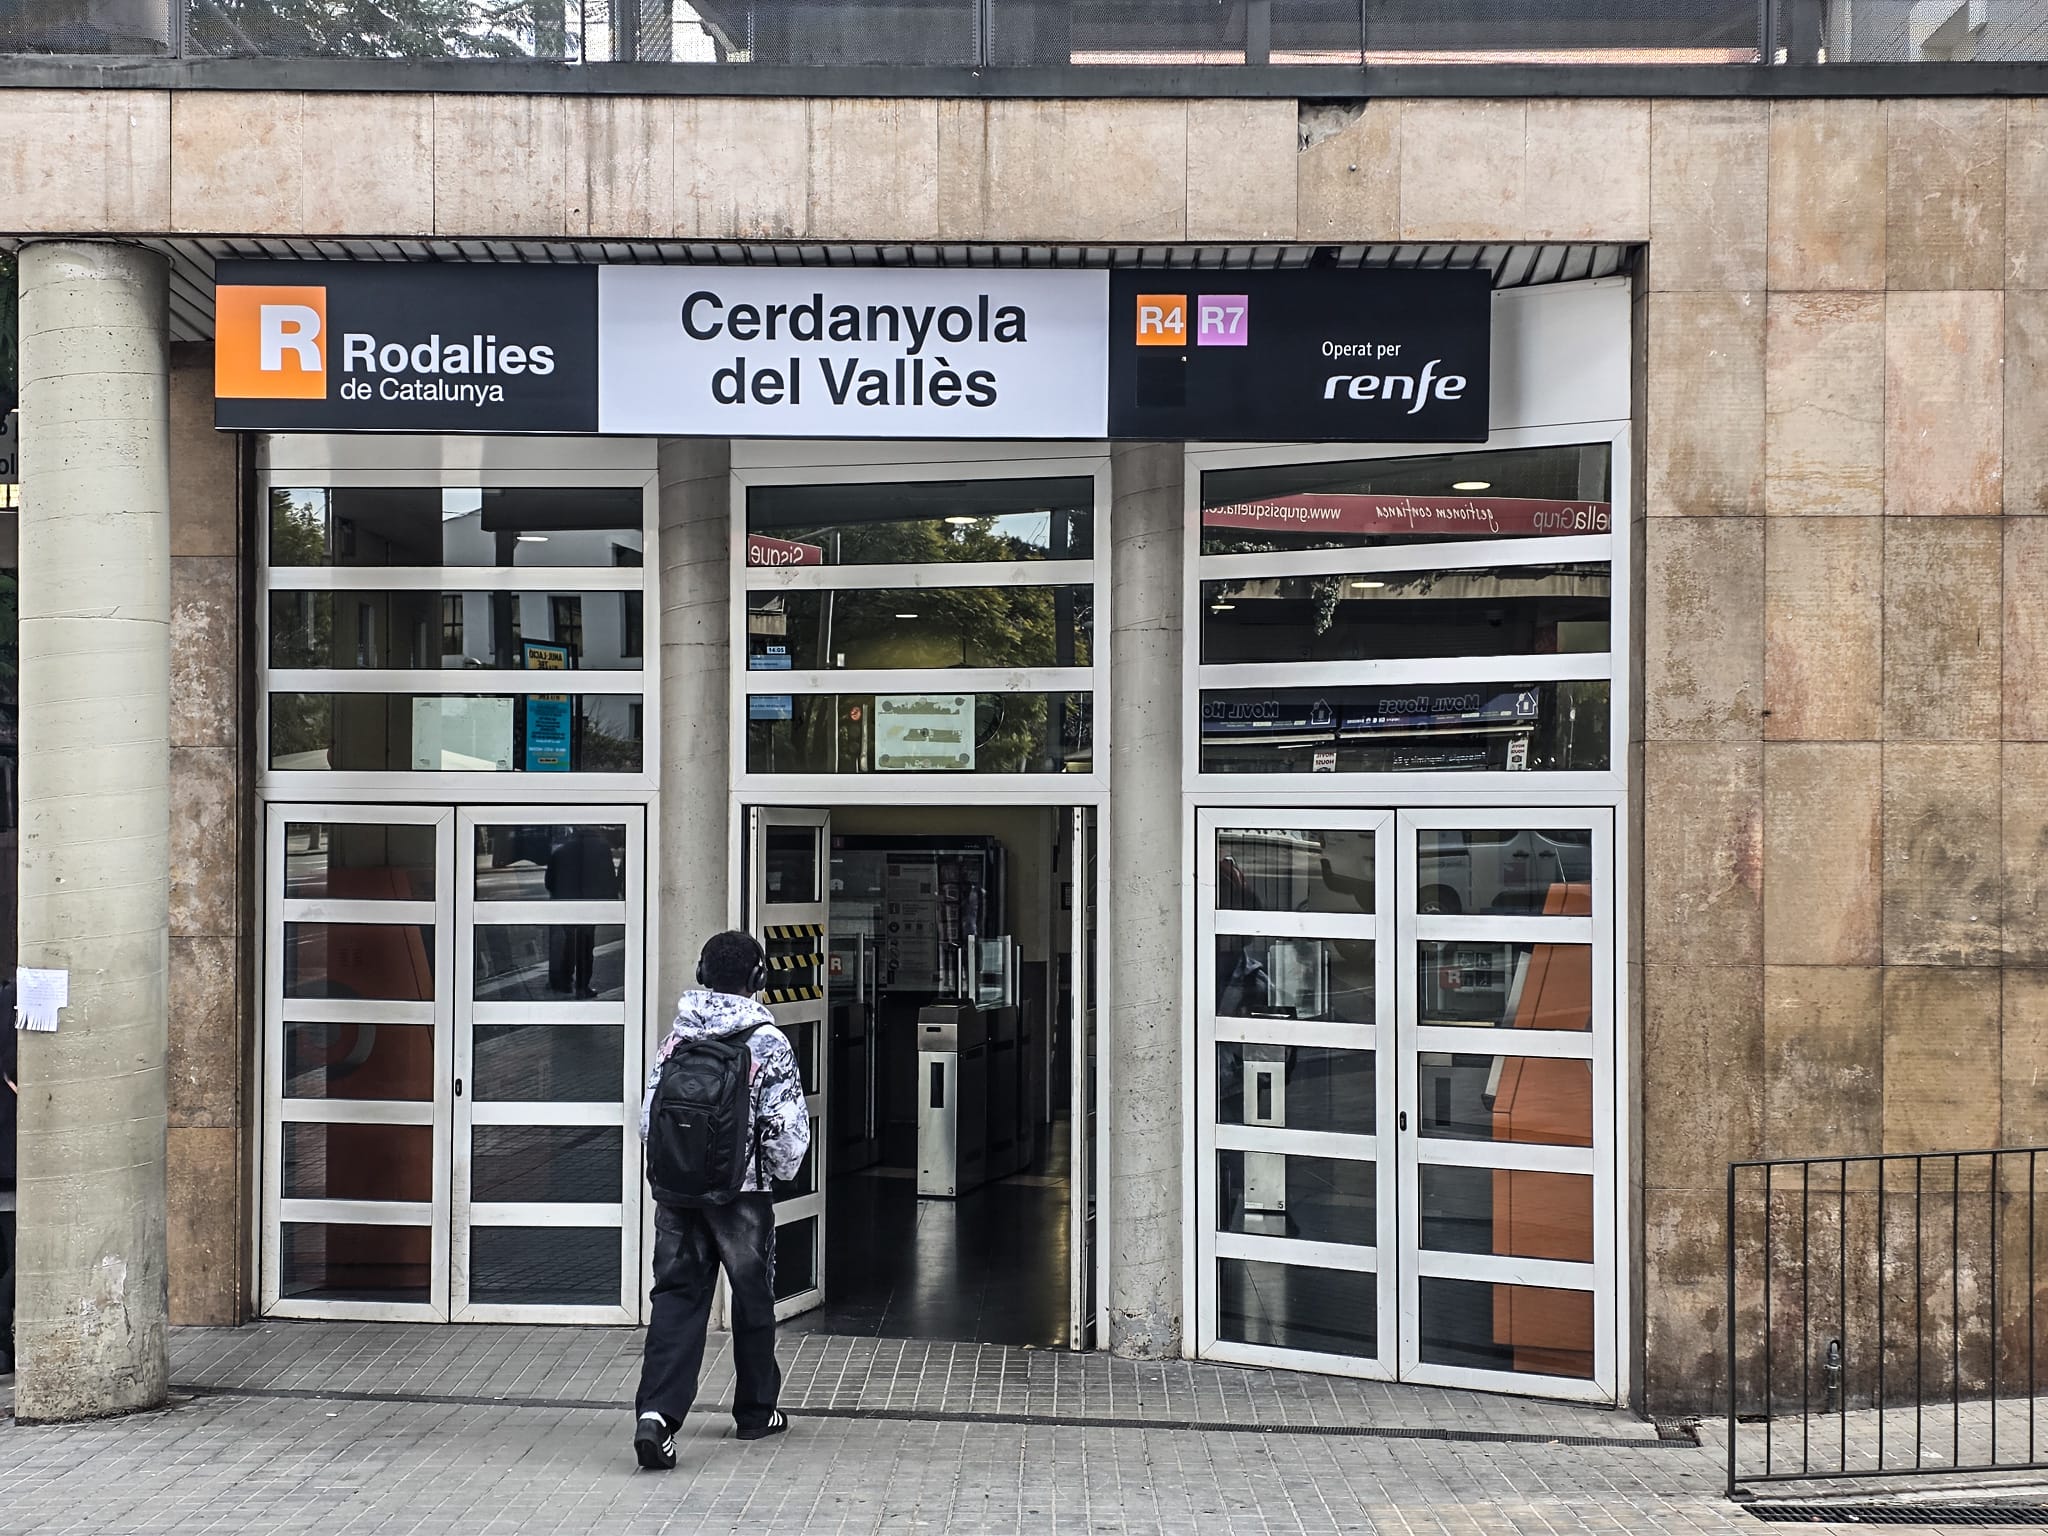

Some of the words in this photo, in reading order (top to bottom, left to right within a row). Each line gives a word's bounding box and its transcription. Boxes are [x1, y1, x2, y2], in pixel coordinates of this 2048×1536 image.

[260, 304, 322, 373] R
[681, 290, 1028, 356] Cerdanyola
[1140, 306, 1184, 334] R4
[1201, 306, 1245, 334] R7
[343, 333, 555, 375] Rodalies
[1321, 340, 1373, 360] Operat
[1377, 343, 1402, 360] per
[340, 377, 373, 401] de
[379, 377, 505, 408] Catalunya
[711, 356, 800, 405] del
[818, 356, 997, 408] Vallès
[1323, 358, 1467, 415] renfe
